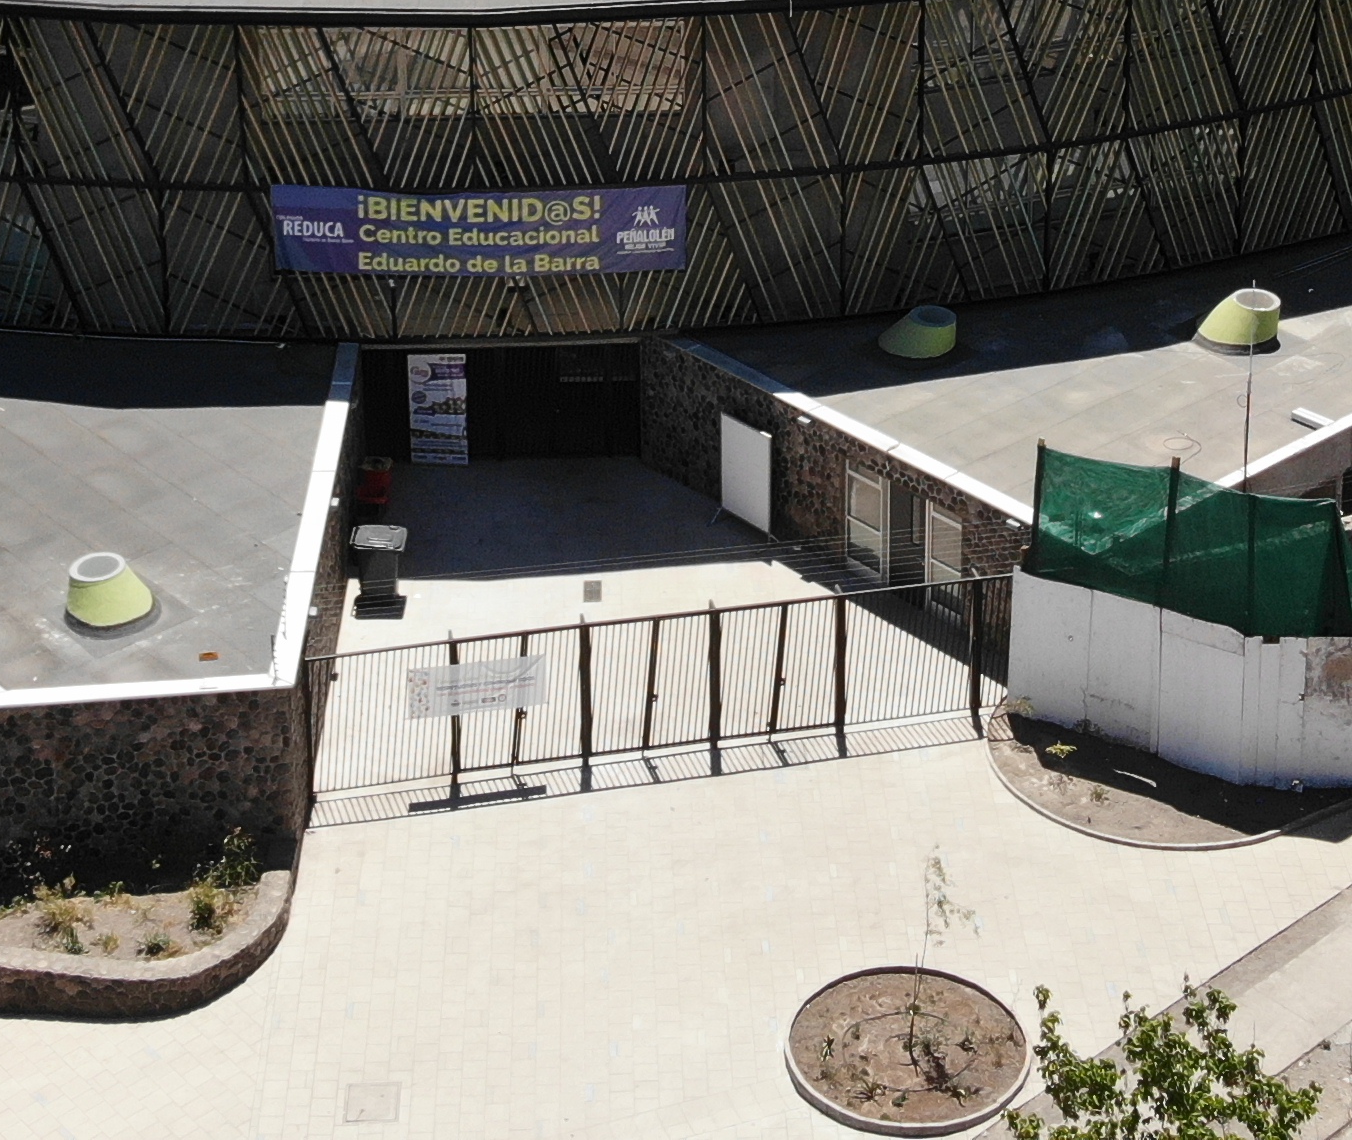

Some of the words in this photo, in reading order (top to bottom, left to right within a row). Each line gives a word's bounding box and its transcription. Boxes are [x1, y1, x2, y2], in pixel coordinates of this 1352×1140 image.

[283, 220, 344, 237] REDUCA
[359, 224, 442, 245] Centro
[448, 225, 600, 246] Educacional
[616, 226, 675, 244] PEÑALOLÉN
[358, 251, 461, 273] Eduardo
[467, 255, 498, 272] de
[505, 255, 527, 273] la
[534, 254, 600, 272] Barra
